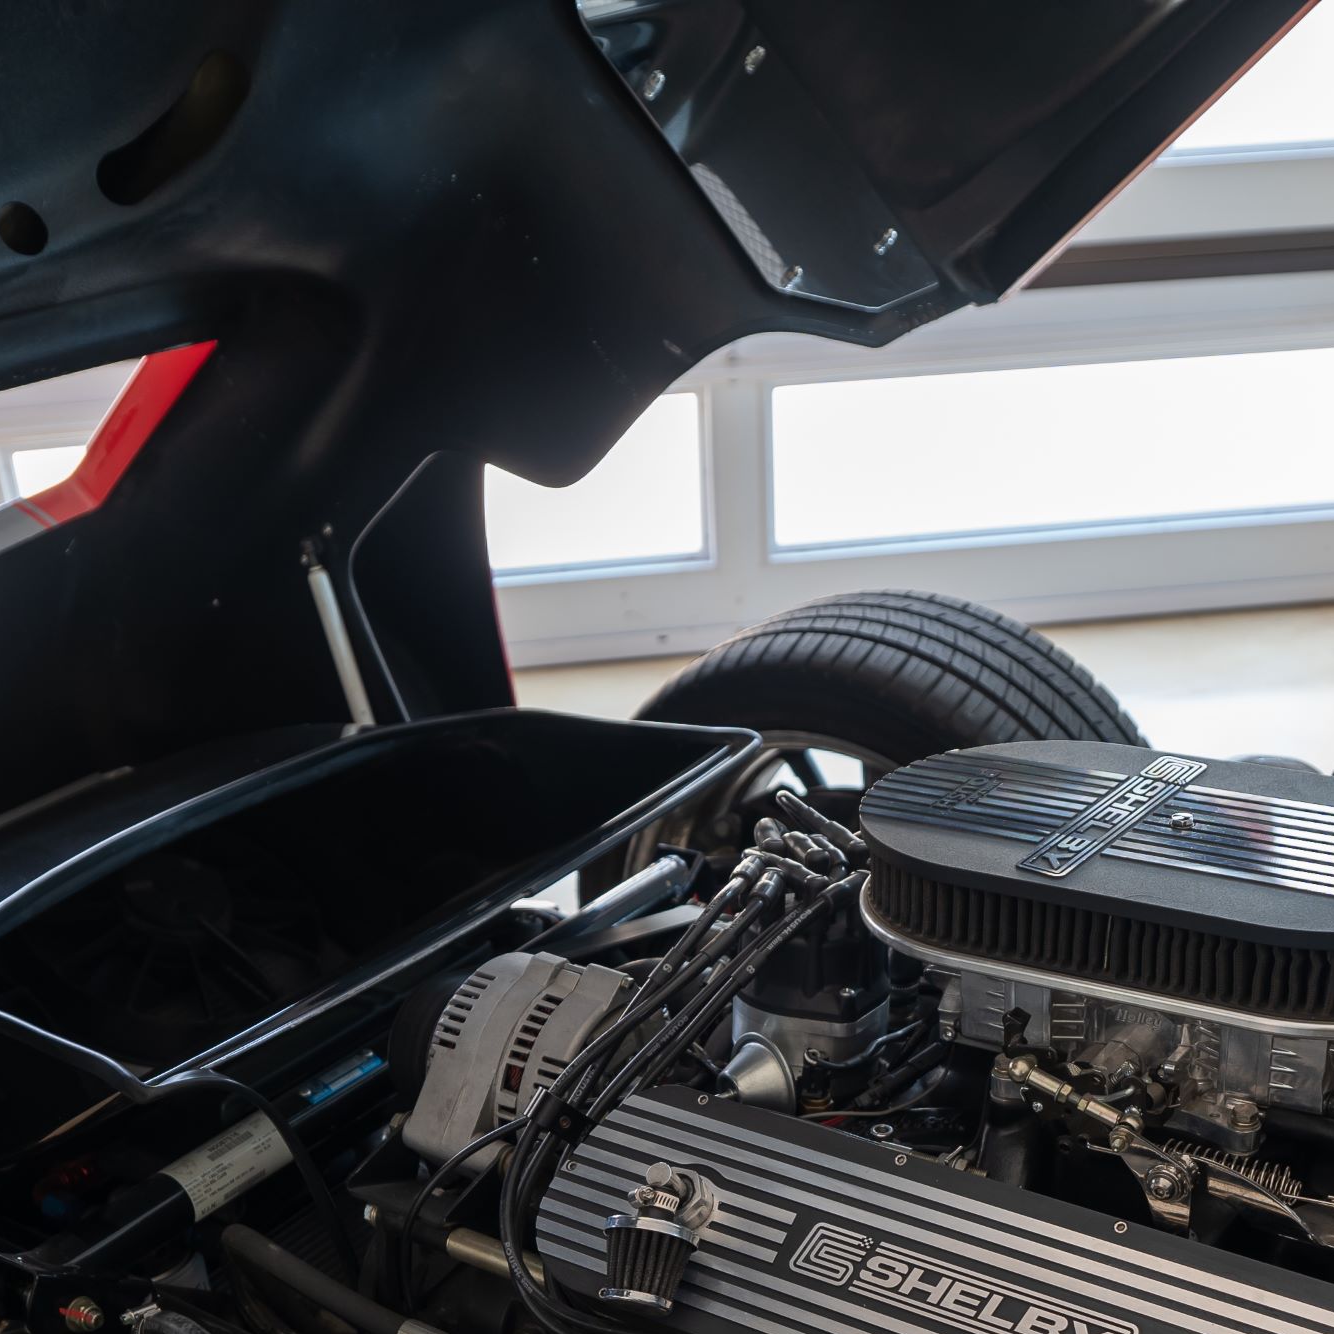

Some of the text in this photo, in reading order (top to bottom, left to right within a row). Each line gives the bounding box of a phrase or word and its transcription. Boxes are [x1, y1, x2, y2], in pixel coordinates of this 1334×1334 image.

[1042, 781, 1166, 869] SHELBY
[745, 964, 756, 975] 8
[1115, 1009, 1163, 1031] Holley
